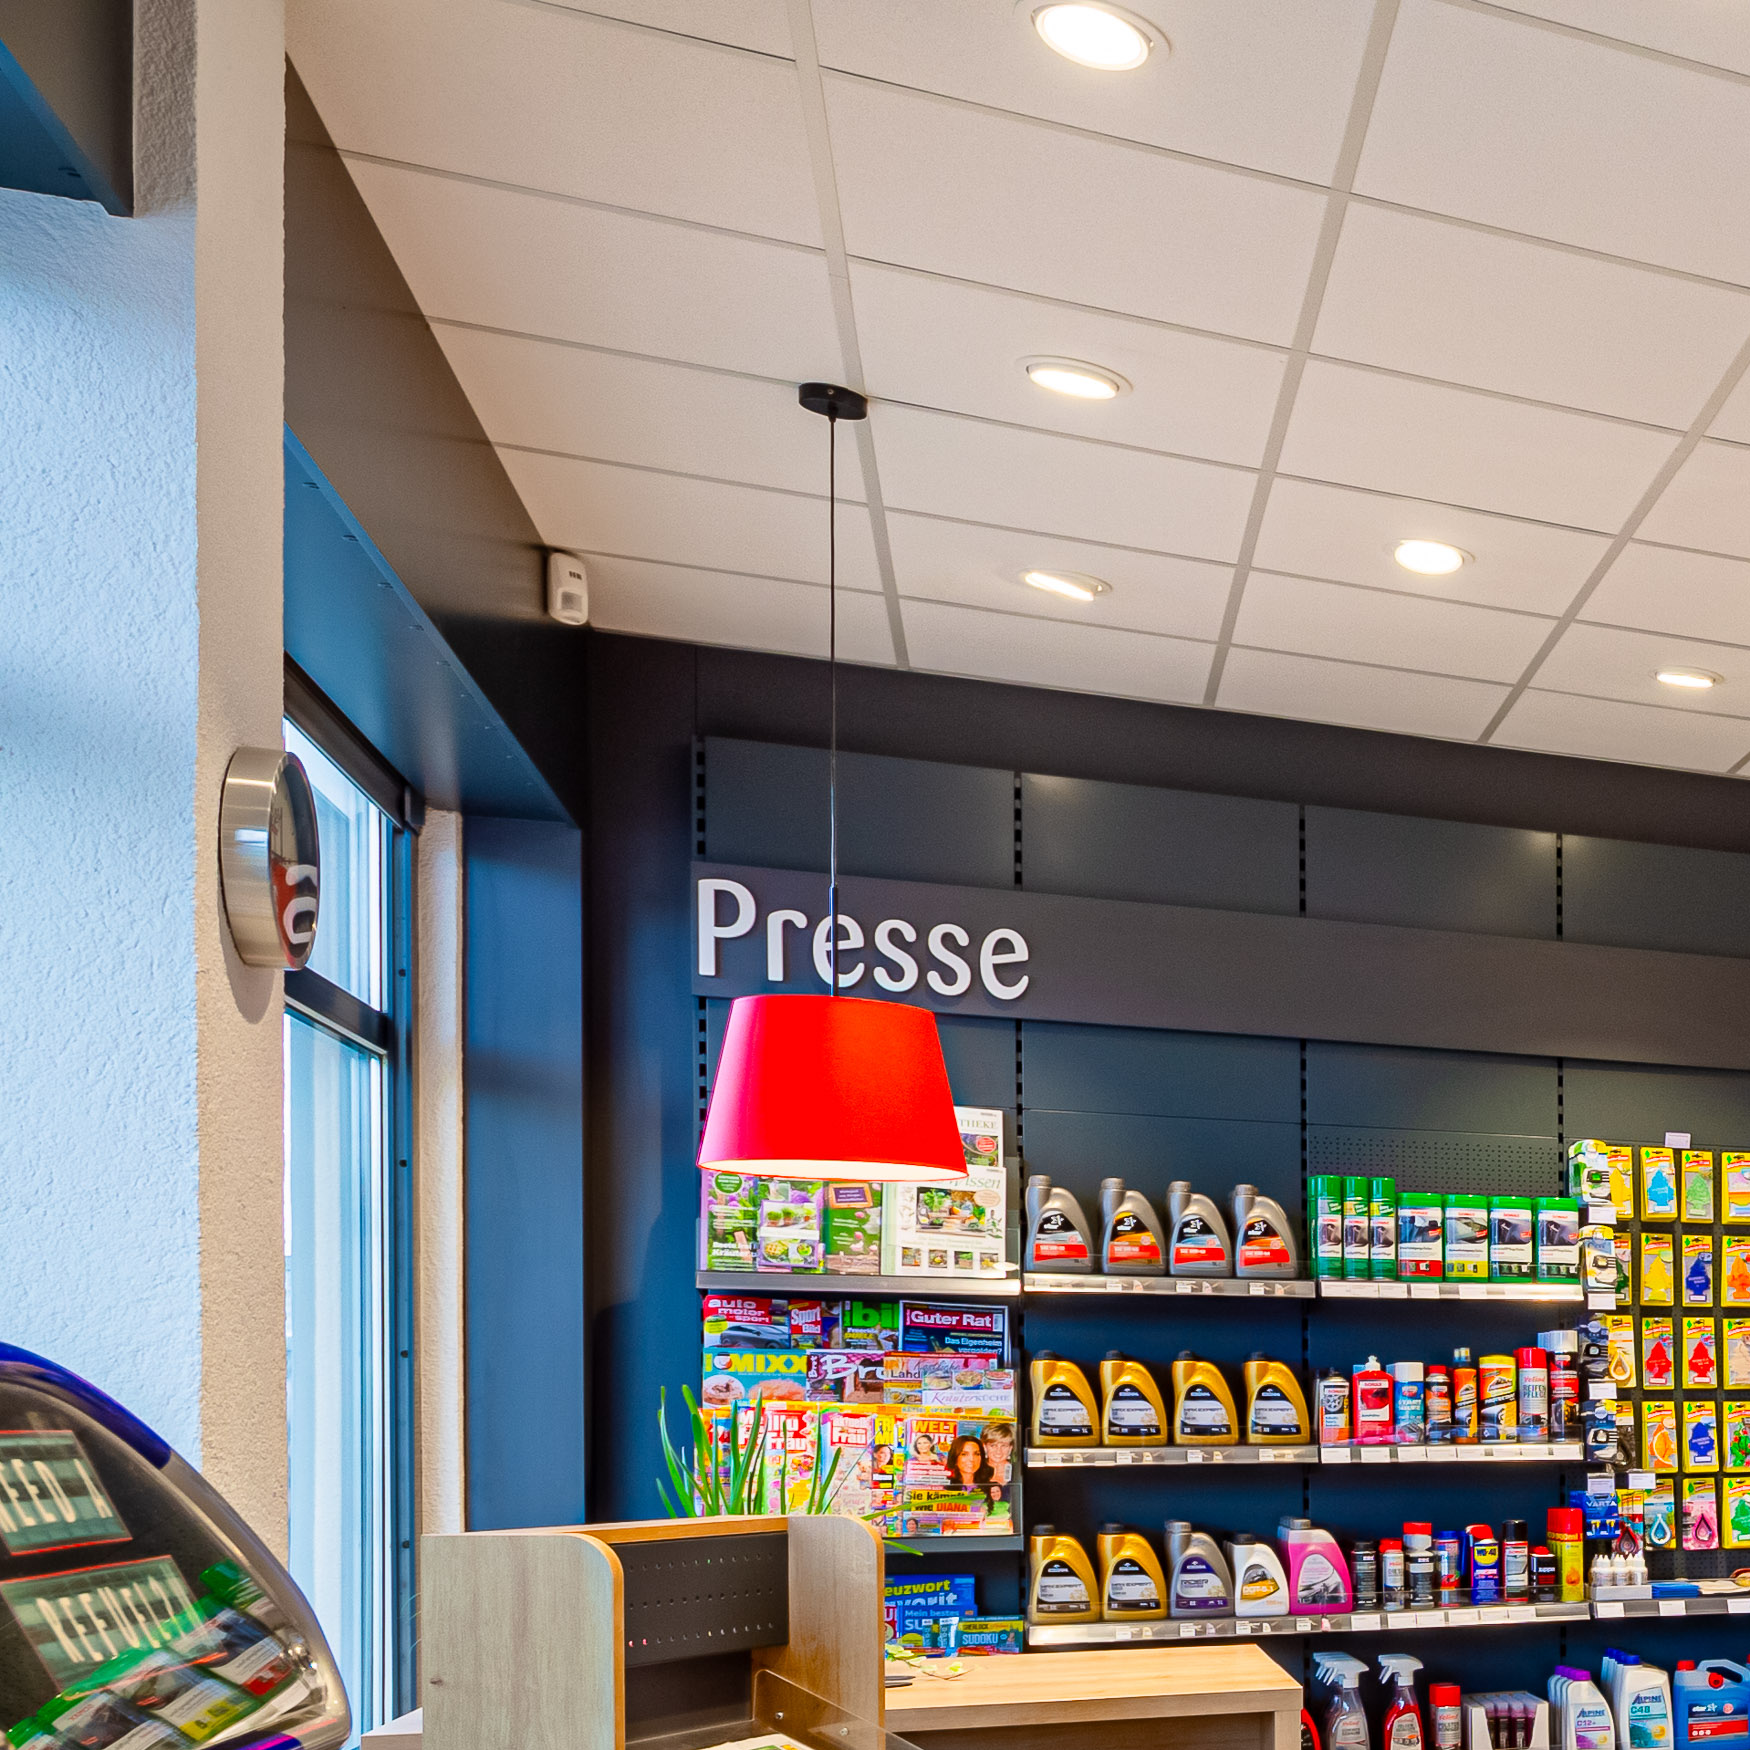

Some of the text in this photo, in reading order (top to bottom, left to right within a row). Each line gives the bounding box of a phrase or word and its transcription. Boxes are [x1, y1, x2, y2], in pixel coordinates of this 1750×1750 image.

[697, 878, 1030, 1000] Presse
[709, 1300, 757, 1308] auto
[791, 1307, 820, 1324] Sport
[912, 1311, 991, 1327] Guter Rat
[906, 1492, 922, 1500] Sie
[936, 1502, 967, 1512] DIANA
[1633, 1694, 1662, 1704] ALPINE
[1577, 1708, 1605, 1719] ALPINE
[1630, 1705, 1650, 1715] C48
